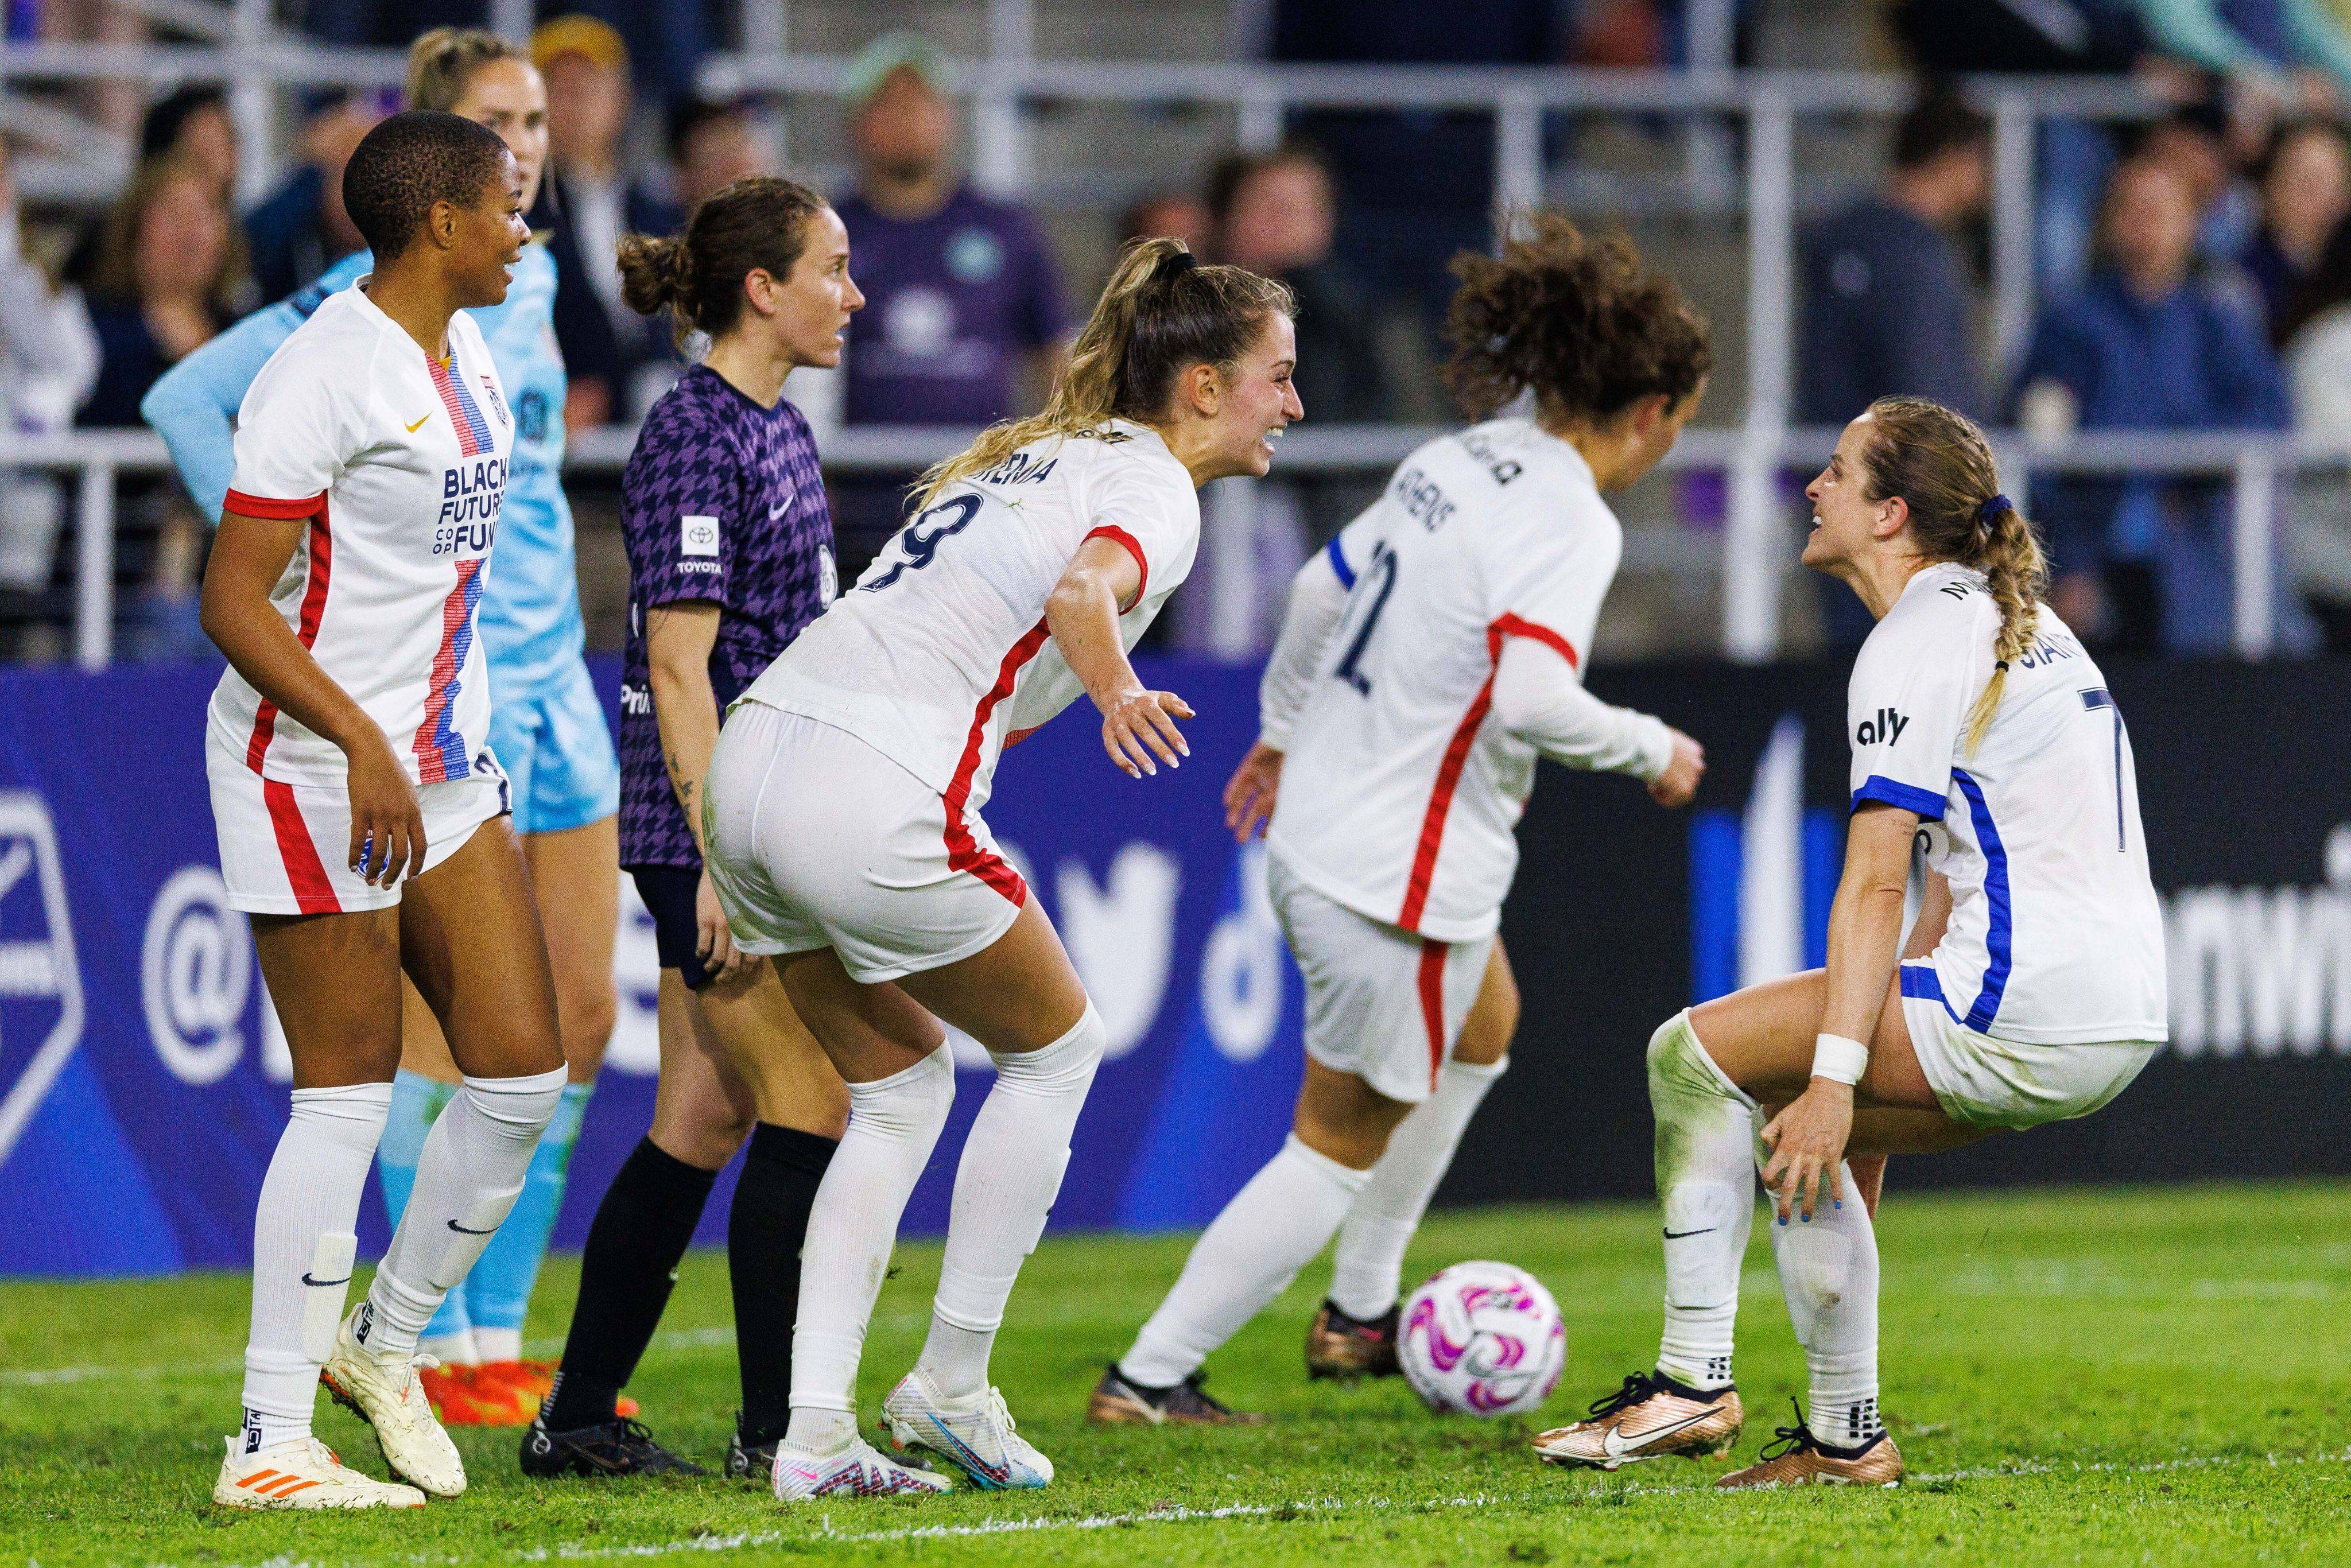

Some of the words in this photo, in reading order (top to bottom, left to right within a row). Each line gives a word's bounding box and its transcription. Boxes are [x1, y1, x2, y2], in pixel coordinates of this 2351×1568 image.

[444, 457, 507, 499] BLACK
[859, 492, 984, 592] 9
[677, 562, 722, 575] TOYOTA
[1856, 708, 1910, 747] ally
[2077, 686, 2125, 853] 7
